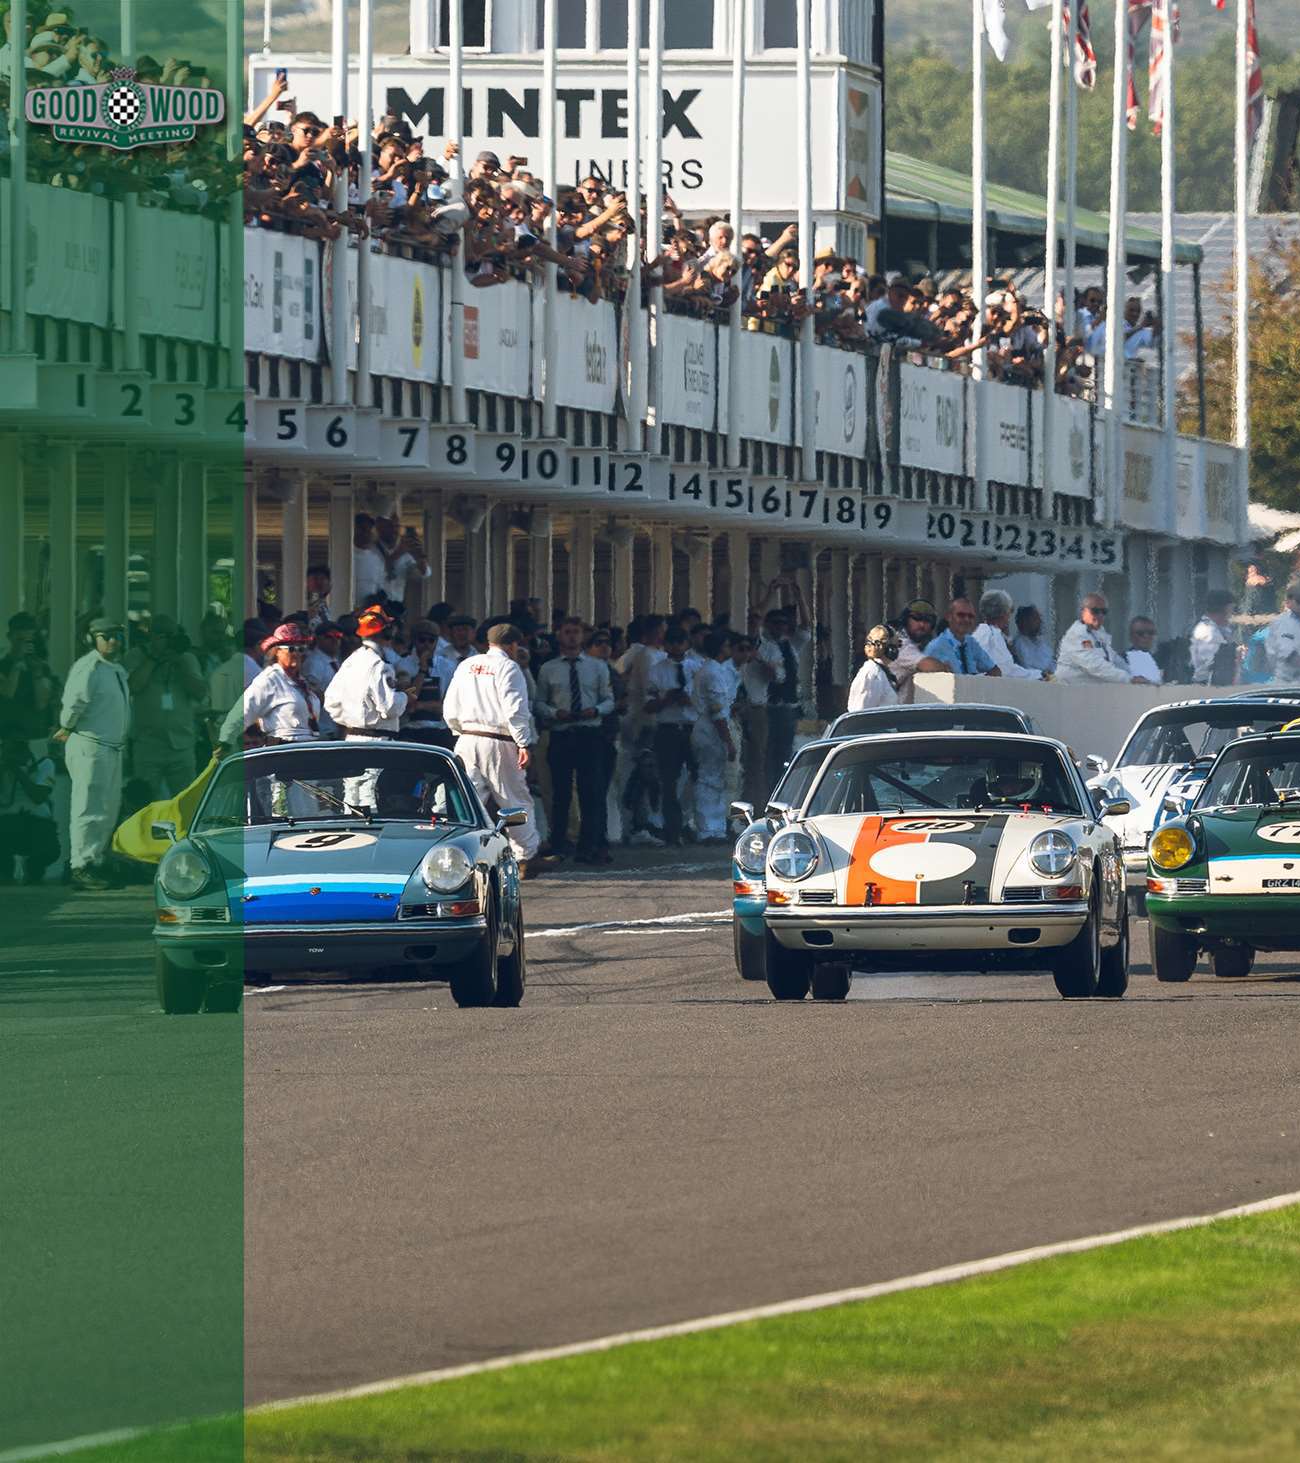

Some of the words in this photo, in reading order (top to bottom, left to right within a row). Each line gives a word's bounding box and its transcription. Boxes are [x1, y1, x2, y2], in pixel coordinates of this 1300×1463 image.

[386, 86, 703, 139] MINTEX
[76, 373, 85, 407] 1
[121, 384, 143, 416] 2
[174, 393, 195, 425] 3
[225, 401, 248, 432] 4
[277, 409, 297, 440] 5
[326, 416, 347, 448] 6
[398, 428, 419, 457] 7
[446, 434, 467, 465] 8
[496, 442, 516, 473] 9
[522, 449, 558, 480] 10
[572, 456, 600, 486] 11
[608, 462, 643, 491] 12
[669, 472, 702, 500] 14
[710, 479, 743, 508] 15
[748, 486, 780, 513] 16
[785, 490, 818, 518] 17
[823, 496, 855, 523] 18
[861, 502, 891, 529] 19
[960, 519, 990, 546] 21
[295, 834, 355, 848] 9
[897, 822, 966, 831] 99
